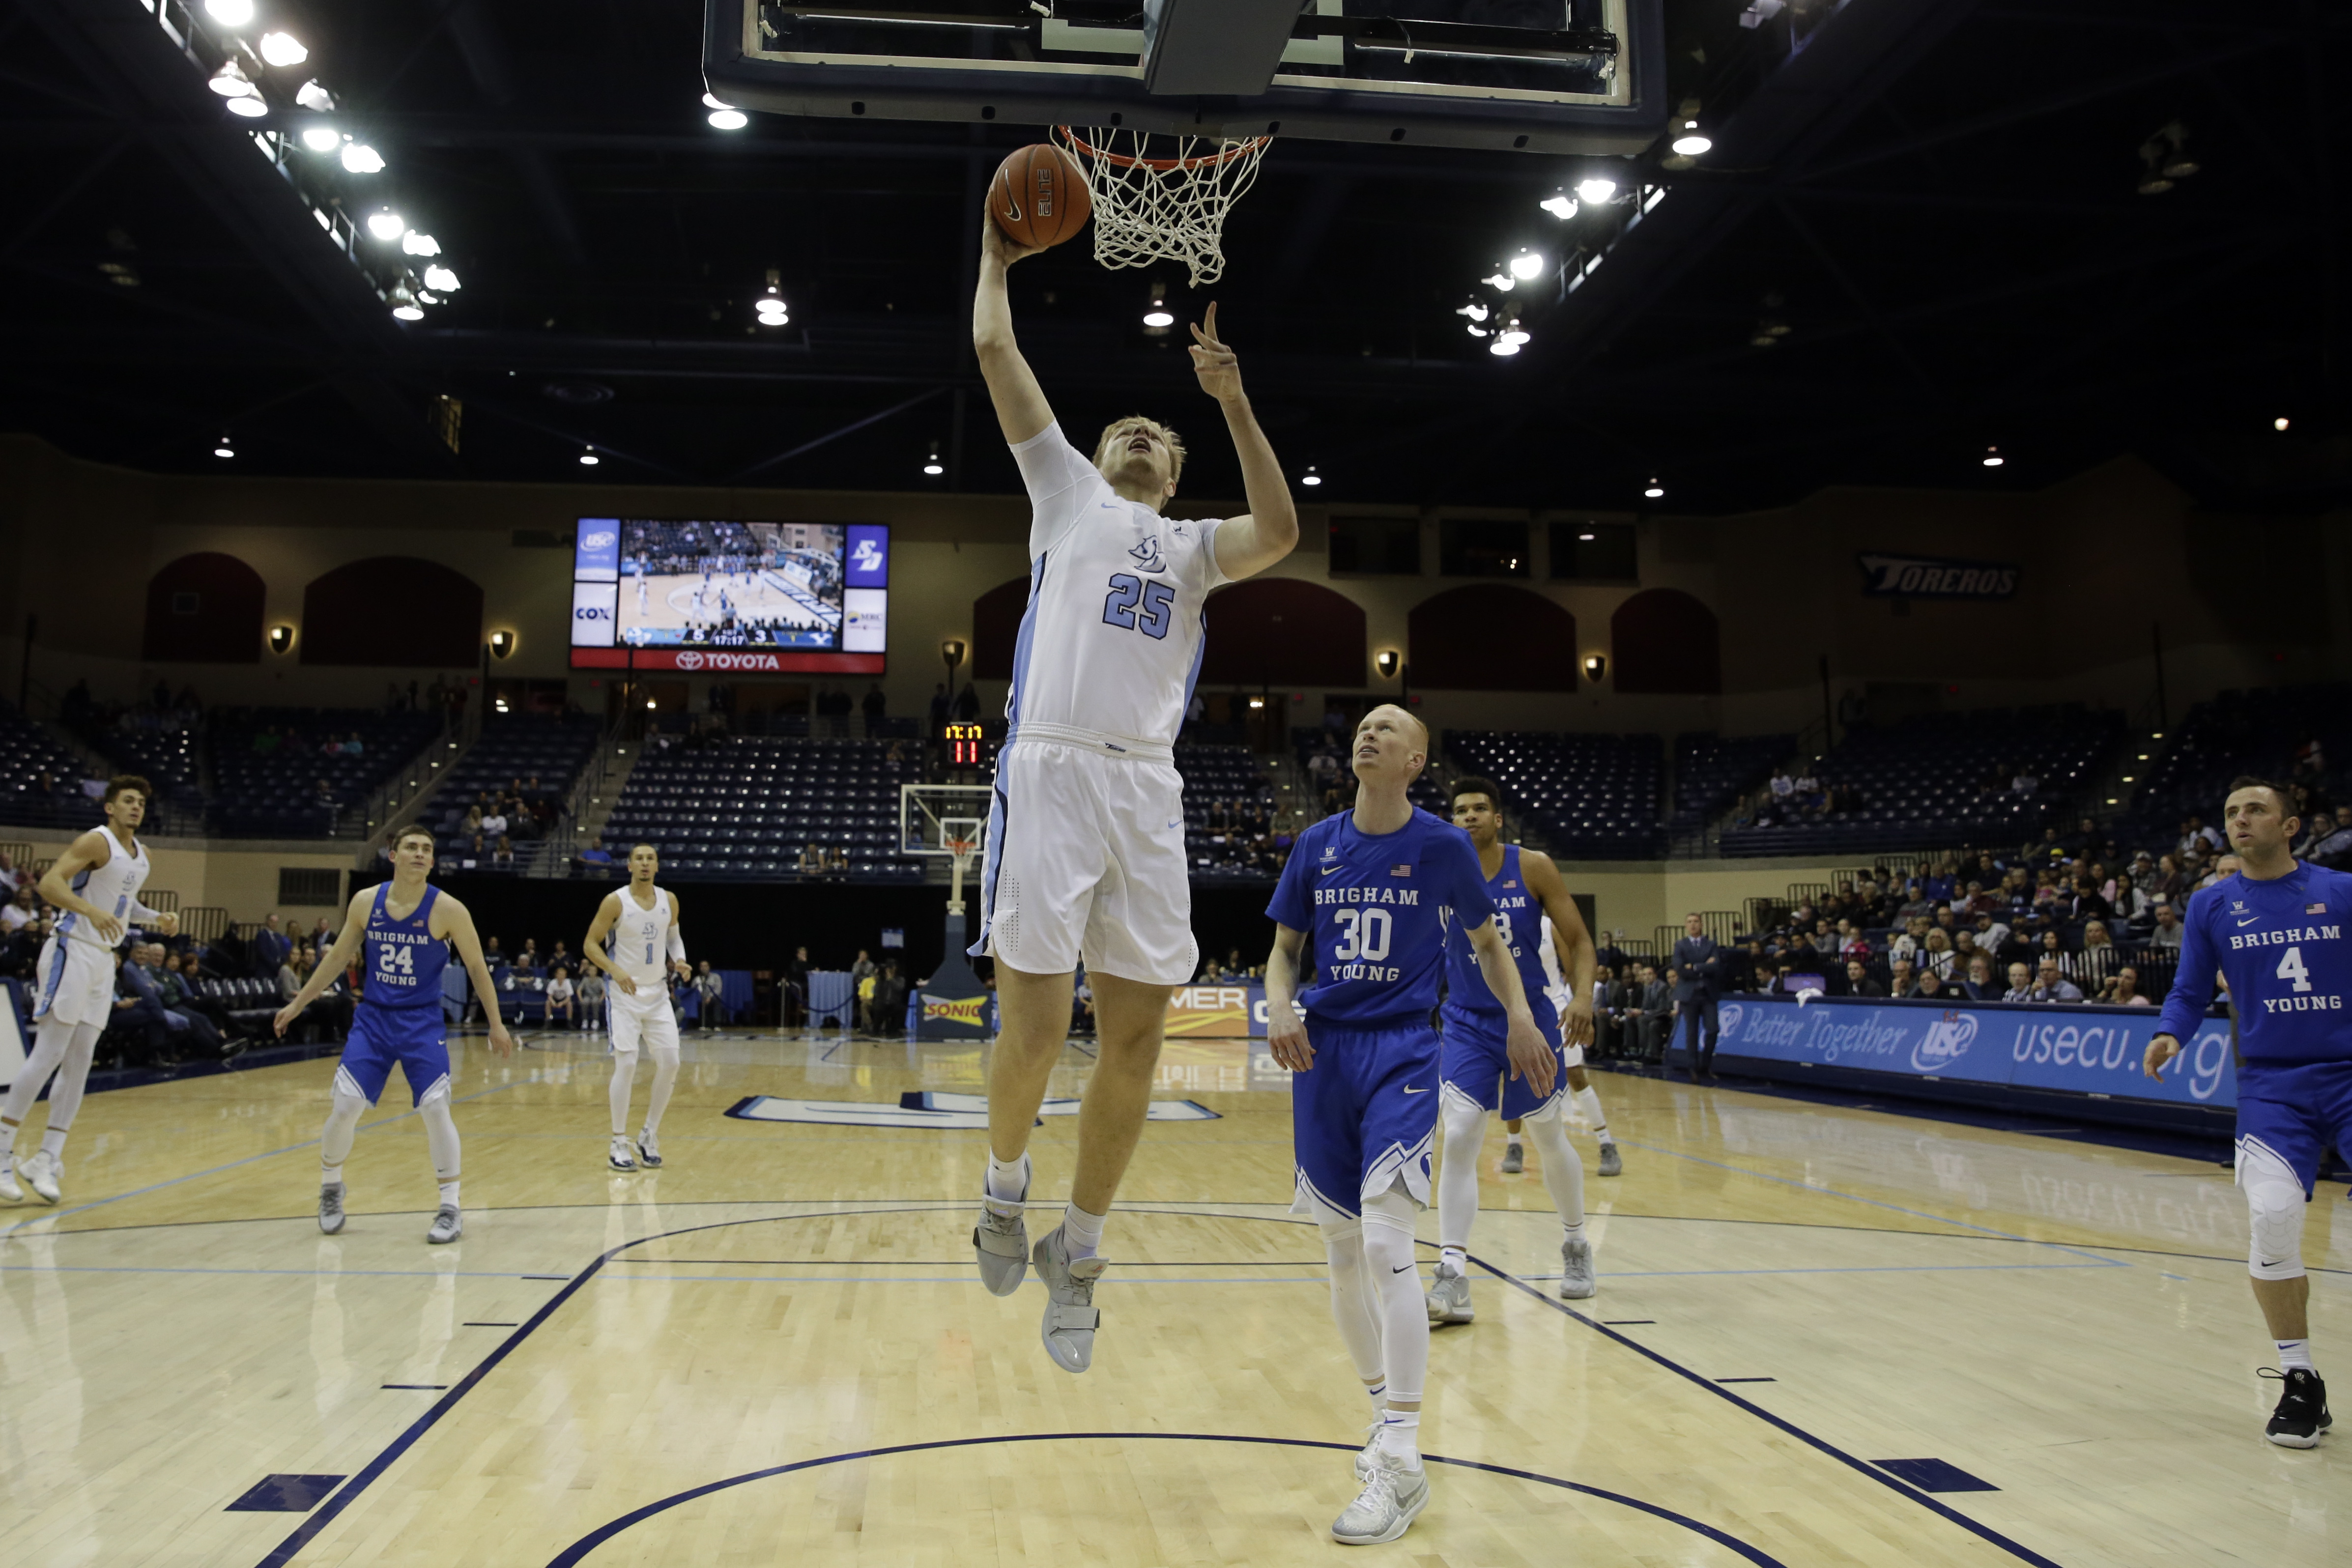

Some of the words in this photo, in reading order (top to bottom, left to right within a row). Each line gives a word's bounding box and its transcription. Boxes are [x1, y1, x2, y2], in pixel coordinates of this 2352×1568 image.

[1037, 169, 1051, 216] ELITE
[1860, 555, 2016, 594] TOREROS
[576, 607, 611, 620] COX
[1103, 573, 1176, 640] 25
[693, 628, 705, 641] 5
[715, 635, 745, 646] 17:17
[755, 629, 767, 642] 3
[706, 654, 779, 669] TOYOTA
[946, 726, 982, 739] 17:17
[956, 741, 977, 763] 11
[1315, 887, 1418, 905] BRIGHAM
[367, 930, 429, 945] BRIGHAM
[1334, 908, 1392, 961] 30
[2230, 925, 2341, 949] BRIGHAM
[380, 943, 413, 974] 24
[1330, 964, 1400, 981] YOUNG
[2276, 947, 2312, 992] 4
[375, 971, 417, 986] YOUNG
[926, 1003, 982, 1017] SONIC
[2264, 996, 2342, 1013] YOUNG
[1742, 1007, 1805, 1046] Better
[1805, 1010, 1908, 1061] Together
